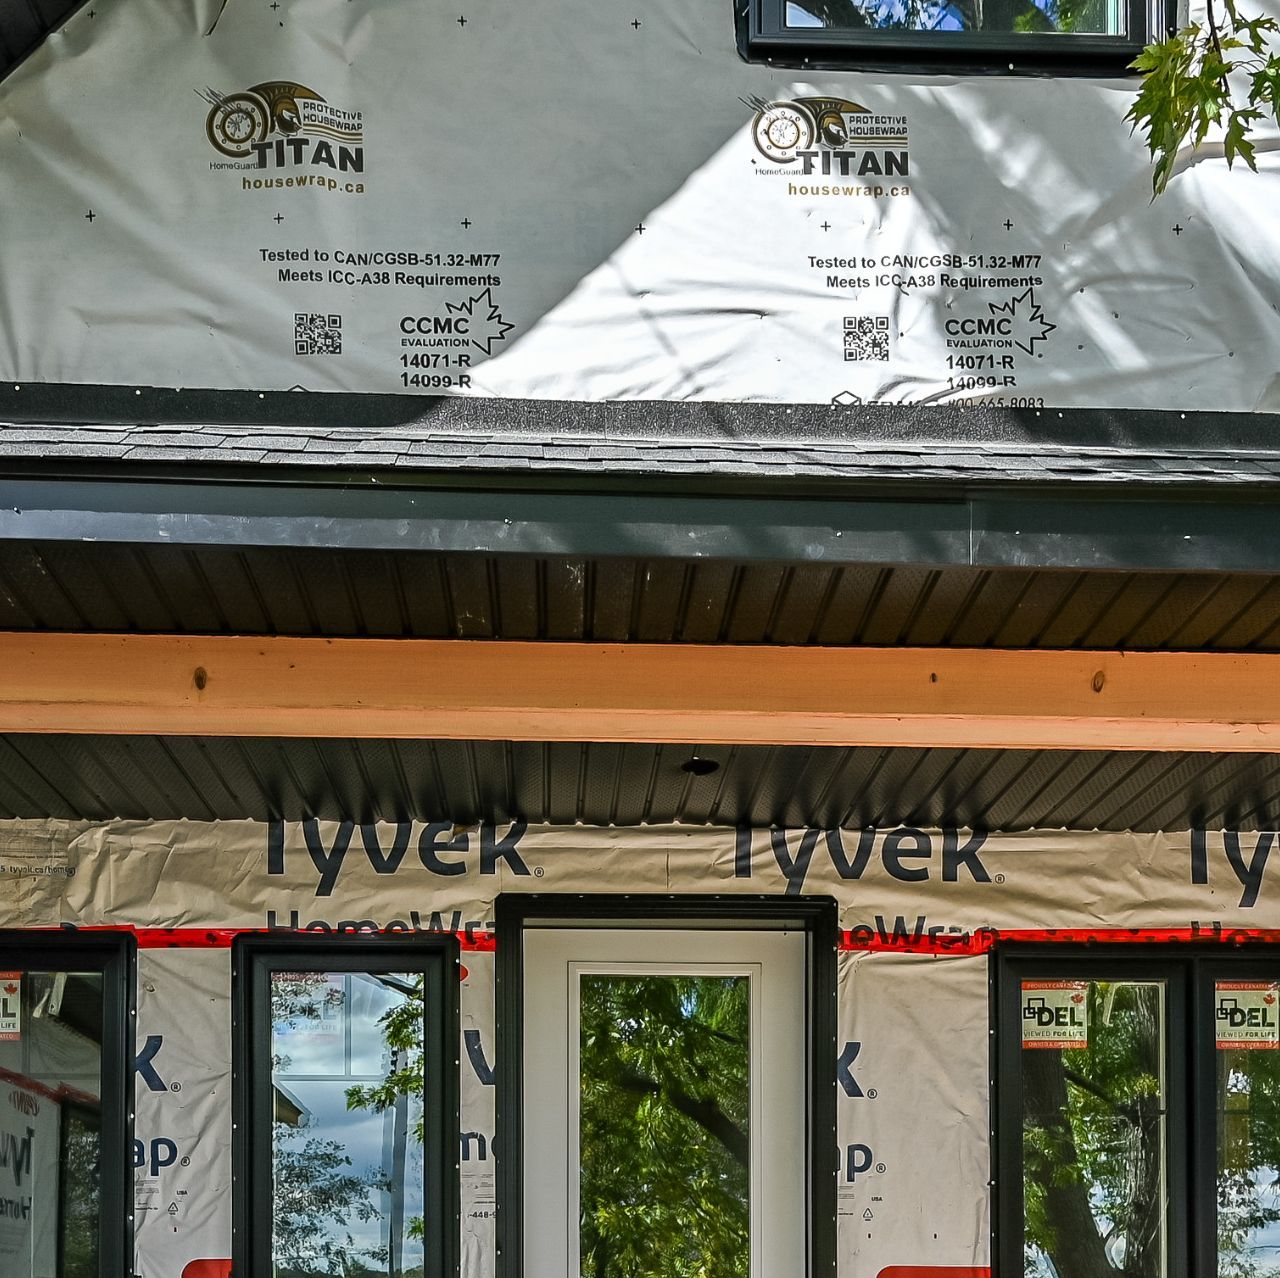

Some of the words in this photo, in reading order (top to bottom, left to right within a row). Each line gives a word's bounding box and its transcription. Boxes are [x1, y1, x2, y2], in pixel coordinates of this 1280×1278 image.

[303, 101, 363, 121] PROTECTIVE
[303, 113, 363, 132] HOUSEWRAP
[849, 115, 908, 125] PROTECTIVE
[849, 126, 908, 136] HOUSEWRAP
[250, 138, 364, 174] TITAN
[796, 151, 909, 176] TITAN
[242, 175, 365, 194] housewrap.ca
[788, 183, 910, 199] housewrap.ca
[259, 248, 309, 263] Tested
[314, 249, 330, 262] to
[334, 250, 501, 267] CAN/CGSB-51.32-M77
[808, 255, 857, 269] Tested
[861, 256, 876, 268] to
[881, 254, 1042, 269] CAN/CGSB-51.32-M77
[278, 268, 323, 283] Meets
[328, 269, 391, 286] ICC-A38
[395, 272, 501, 289] Requirements
[826, 275, 870, 288] Meets
[875, 274, 936, 288] ICC-A38
[940, 274, 1043, 291] Requirements
[400, 316, 470, 334] CCMC
[945, 318, 1013, 335] CCMC
[401, 338, 470, 347] EVALUATION
[946, 339, 1013, 348] EVALUATION
[400, 353, 471, 368] 14071-R
[946, 355, 1015, 369] 14071-R
[400, 371, 472, 389] 14099-R
[946, 375, 1017, 391] 14099-R
[1037, 1006, 1084, 1027] DEL
[1229, 1007, 1275, 1028] DEL
[1023, 1030, 1051, 1038] VIEWED
[1052, 1030, 1067, 1038] FOR
